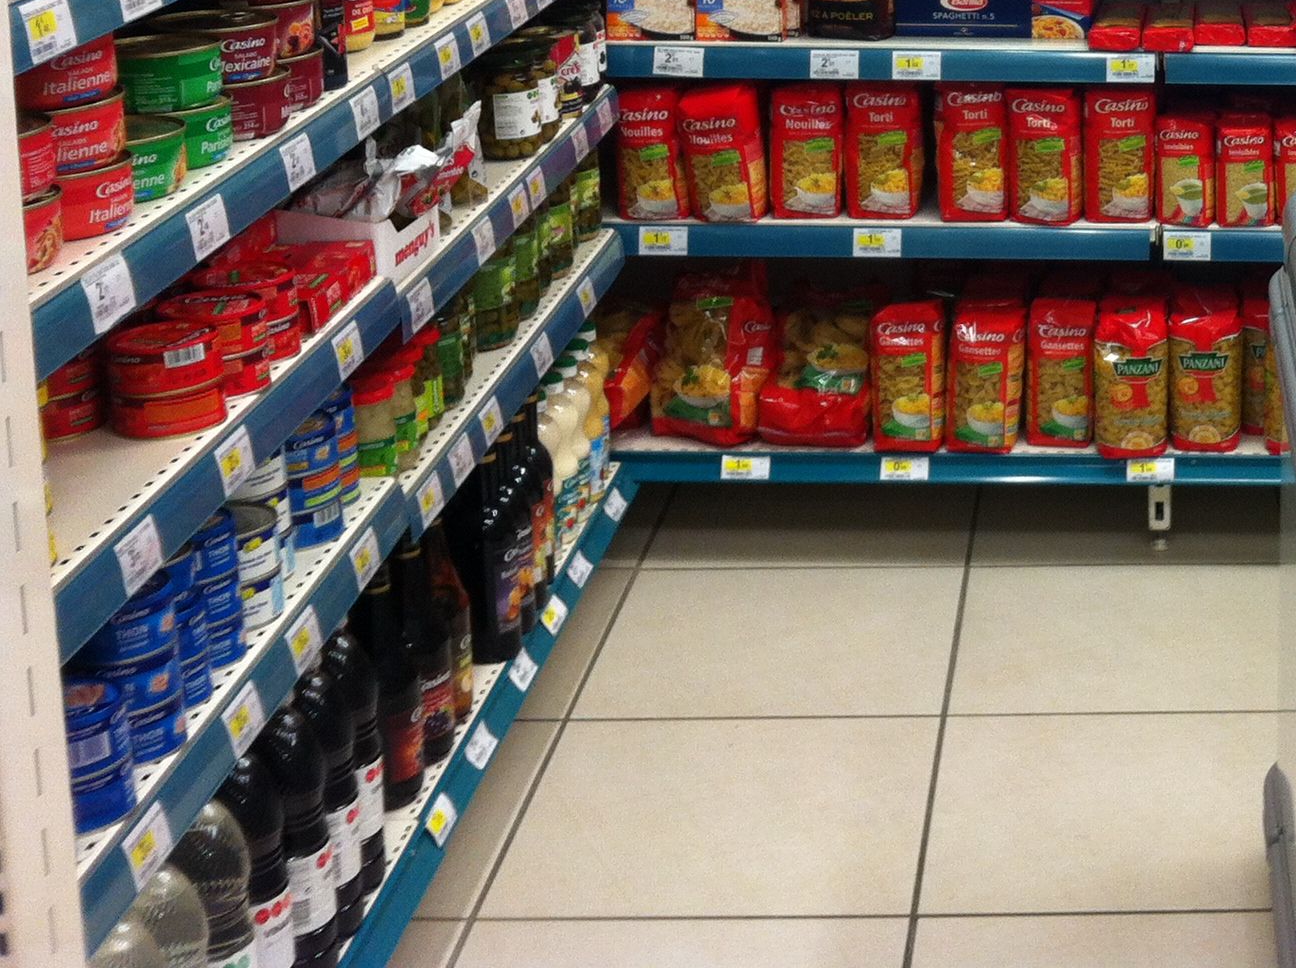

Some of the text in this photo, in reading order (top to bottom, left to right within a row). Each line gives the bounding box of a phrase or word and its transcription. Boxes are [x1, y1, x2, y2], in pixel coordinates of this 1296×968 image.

[932, 11, 980, 20] SPAGHETTI
[221, 36, 265, 52] Casino
[50, 49, 103, 69] Casino
[43, 71, 111, 96] Italienne
[853, 93, 907, 108] Casino
[947, 92, 1002, 106] Casino
[1012, 99, 1065, 113] Casino
[1095, 98, 1149, 113] Casino
[869, 111, 893, 123] Torti
[962, 109, 988, 120] Torti
[683, 117, 735, 130] Casino
[785, 119, 833, 131] Nouilles
[1110, 117, 1135, 128] Torti
[1160, 129, 1199, 140] Casino
[1224, 135, 1265, 147] Casino
[878, 322, 924, 337] Casino
[1038, 324, 1086, 339] Casino
[1116, 360, 1159, 375] PANZANI
[1182, 356, 1225, 371] PANZANI
